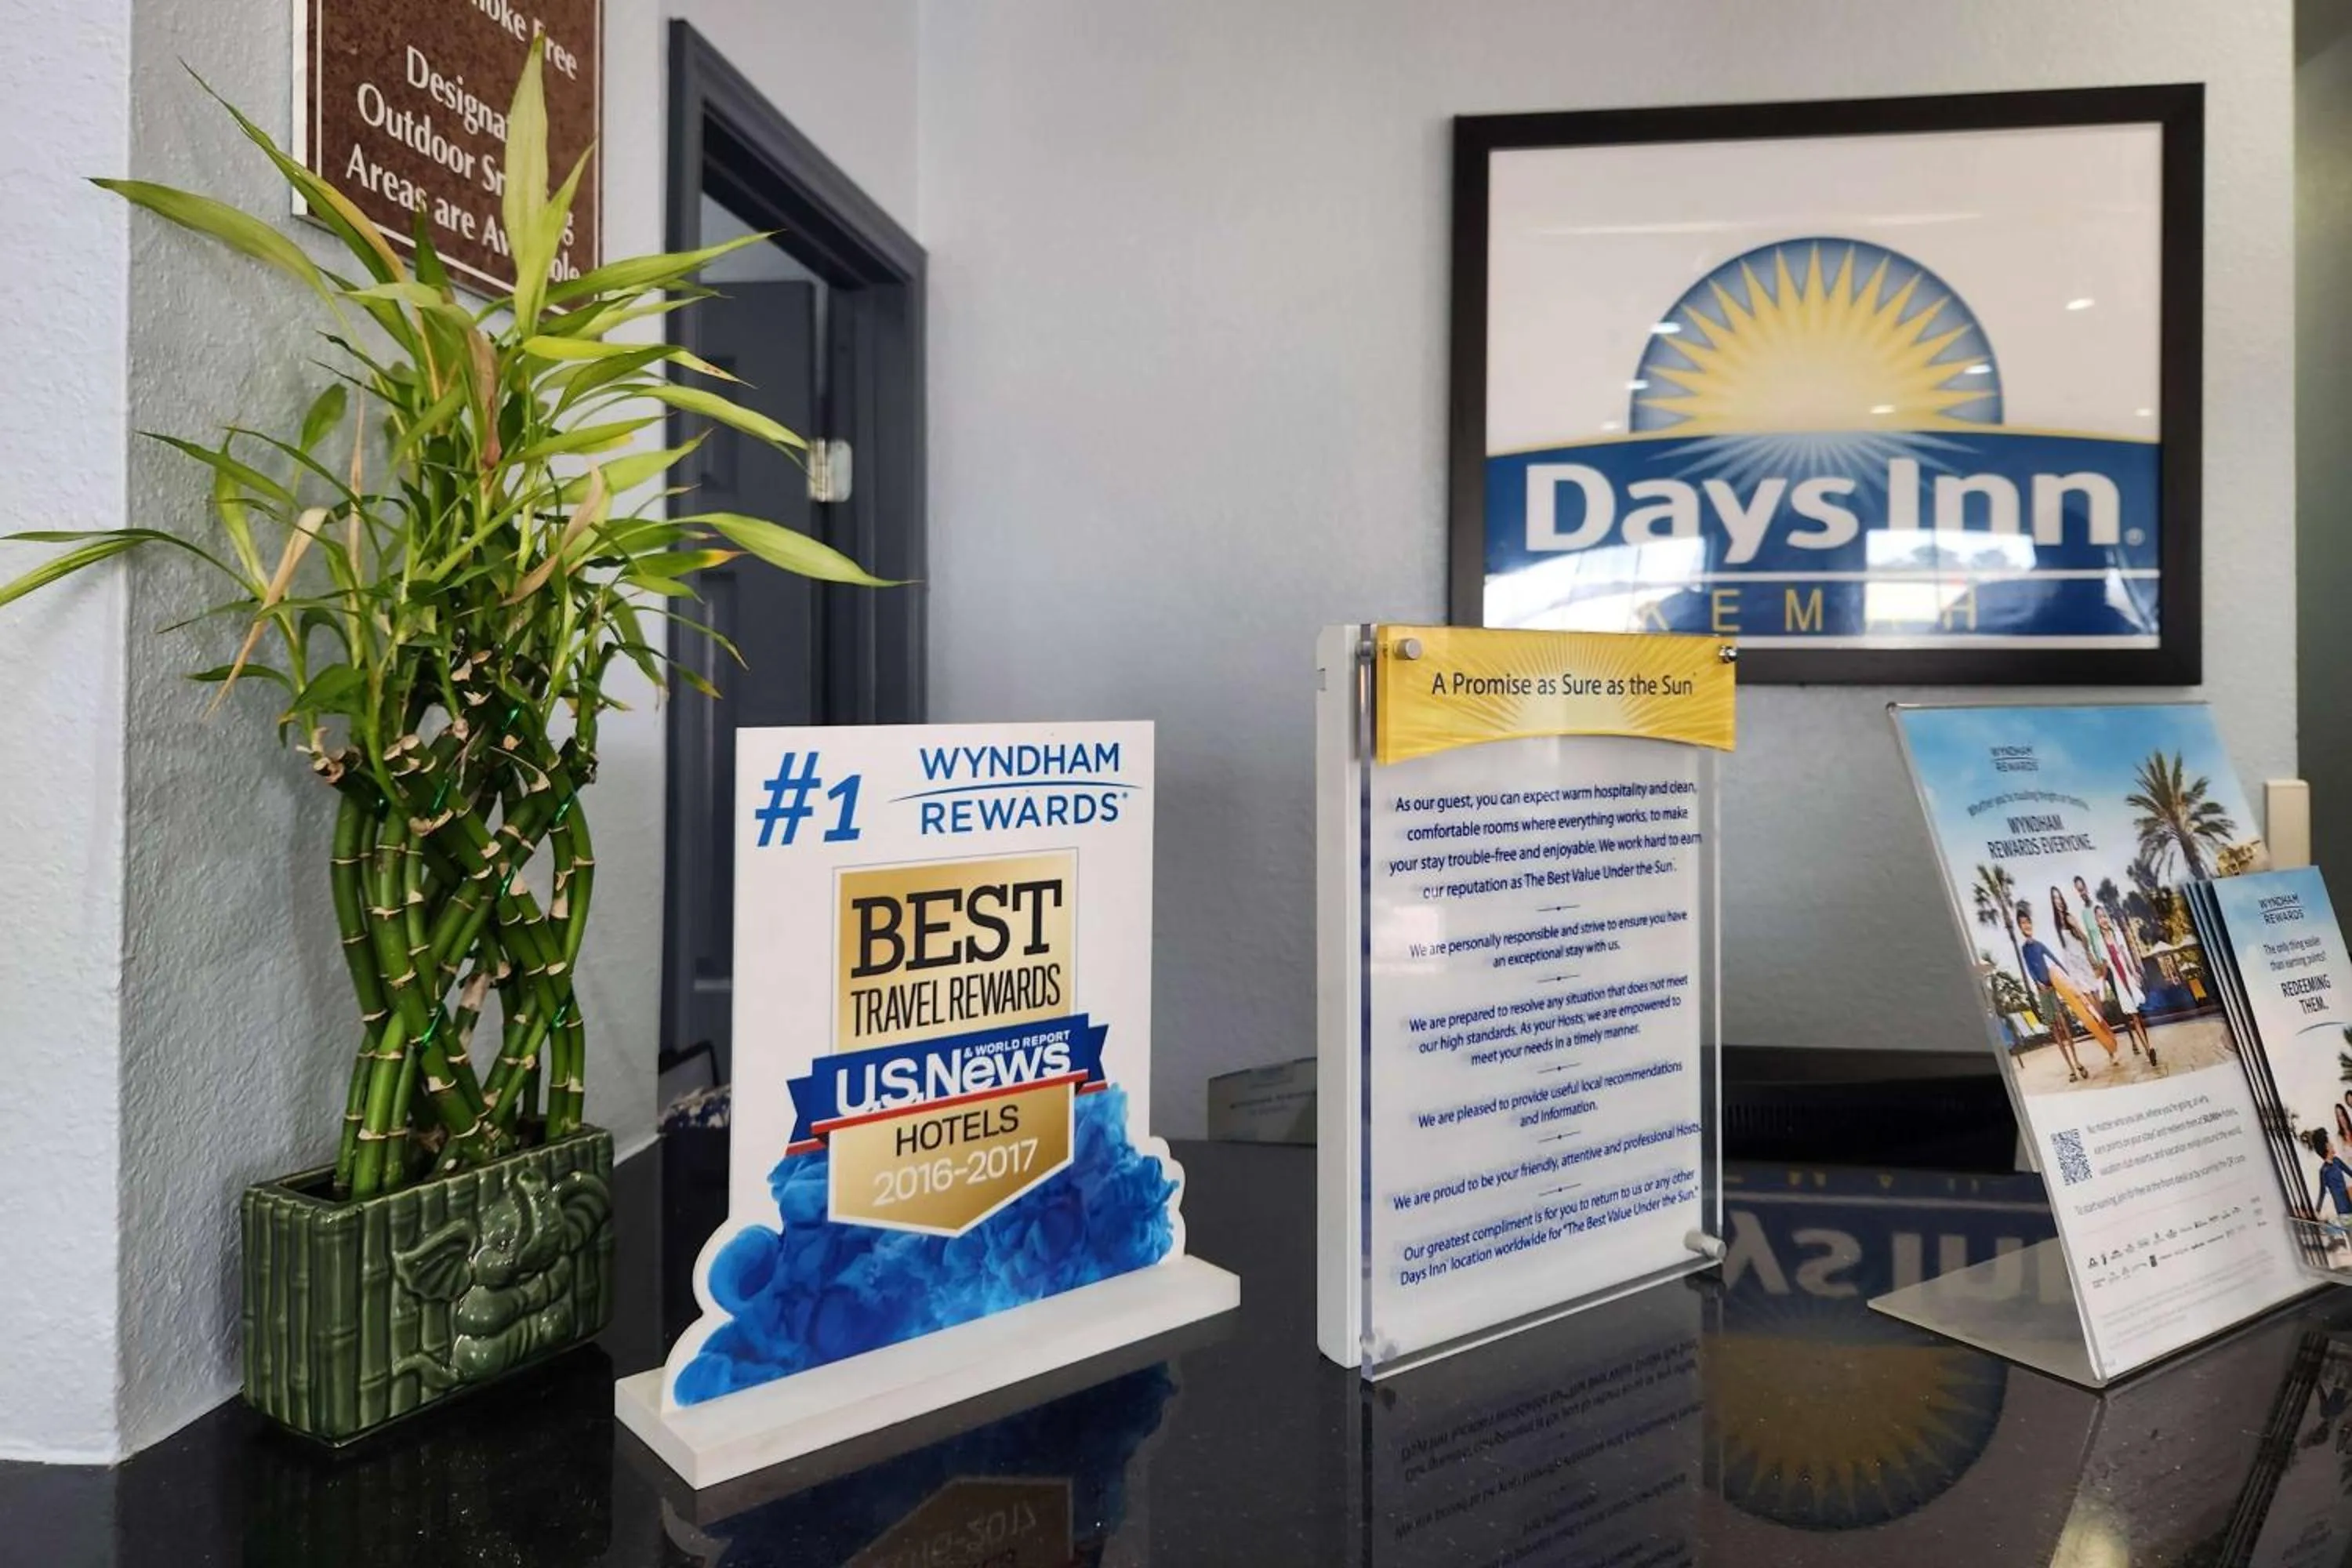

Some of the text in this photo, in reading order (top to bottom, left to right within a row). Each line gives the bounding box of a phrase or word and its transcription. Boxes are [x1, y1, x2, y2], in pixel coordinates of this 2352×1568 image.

[358, 83, 477, 180] Outdoor
[346, 143, 426, 212] Areas
[434, 198, 475, 239] are
[1526, 463, 1858, 563] Days
[1432, 673, 1446, 695] A
[1453, 672, 1531, 695] Promise
[1537, 677, 1556, 695] as
[1563, 674, 1602, 695] Sure
[1607, 678, 1624, 695] as
[1630, 674, 1657, 695] the
[755, 742, 1120, 847] #1 WYNDHAM
[1396, 797, 1410, 811] As
[1414, 800, 1435, 810] our
[1437, 795, 1473, 812] guest,
[1476, 794, 1497, 809] you
[1500, 793, 1519, 804] can
[1523, 790, 1559, 805] expect
[1563, 789, 1592, 800] warm
[1595, 784, 1646, 800] hospitality
[1650, 782, 1667, 794] and
[1407, 806, 1688, 840] comfortable rooms where everything works, to make
[1987, 837, 2042, 858] REWARDS
[1389, 833, 1702, 877] your stay trouble-free and enjoyable. We work hard to earn
[1423, 885, 1443, 898] our
[1446, 878, 1508, 898] reputation
[1511, 877, 1522, 888] as
[1524, 873, 1545, 885] The
[1547, 869, 1570, 886] Best
[1572, 867, 1600, 882] Value
[1602, 863, 1634, 879] Under
[1636, 862, 1653, 875] the
[851, 880, 1062, 978] BEST
[1430, 943, 1446, 955] are
[1449, 933, 1502, 956] personally
[1503, 926, 1559, 946] responsible
[1561, 923, 1578, 937] and
[1619, 917, 1647, 928] ensure
[1650, 915, 1667, 927] you
[1668, 911, 1687, 922] have
[2263, 909, 2304, 924] REWARDS
[1493, 940, 1621, 967] an exceptional stay with us.
[851, 963, 1062, 1036] TRAVEL REWARDS
[1410, 1019, 1427, 1033] We
[1430, 1017, 1446, 1029] are
[1449, 1005, 1494, 1029] prepared
[1497, 1006, 1508, 1017] to
[1510, 998, 1544, 1014] resolve
[1547, 996, 1563, 1010] any
[1566, 989, 1606, 1005] situation
[1607, 985, 1625, 997] that
[1628, 982, 1648, 994] does
[2281, 974, 2331, 997] REDEEMING
[975, 1038, 1020, 1055] WORLD
[1023, 1029, 1071, 1047] REPORT
[1419, 996, 1681, 1054] our high standards. As your Hosts, we are empowered to
[1472, 1023, 1639, 1066] meet your needs in a timely manner.
[1418, 1115, 1436, 1127] We
[1438, 1112, 1454, 1125] are
[1457, 1099, 1497, 1123] pleased
[1499, 1098, 1509, 1110] to
[1512, 1090, 1548, 1109] provide
[1551, 1083, 1579, 1098] useful
[1604, 1061, 1682, 1086] recommendations
[1520, 1100, 1598, 1127] and information.
[896, 1105, 1019, 1156] HOTELS
[873, 1138, 1038, 1207] 2016-2017
[1394, 1196, 1411, 1210] We
[1414, 1193, 1430, 1206] are
[1433, 1179, 1465, 1203] proud
[1468, 1178, 1479, 1191] to
[1481, 1174, 1494, 1187] be
[1497, 1169, 1519, 1186] your
[1561, 1148, 1602, 1167] attentive
[1604, 1140, 1621, 1154] and
[1624, 1125, 1675, 1153] professional
[1400, 1270, 1426, 1285] Days
[1429, 1263, 1446, 1276] Inn
[1451, 1250, 1491, 1269] location
[1494, 1231, 1546, 1256] worldwide
[1548, 1227, 1563, 1240] for
[1587, 1215, 1606, 1229] Best
[1607, 1207, 1632, 1222] Value
[1634, 1200, 1661, 1215] Under
[1662, 1194, 1676, 1207] the
[1404, 1246, 1425, 1261] Our
[1427, 1232, 1470, 1258] greatest
[1472, 1216, 1532, 1239] compliment
[1534, 1210, 1543, 1223] is
[1544, 1207, 1559, 1219] for
[1559, 1202, 1577, 1219] you
[1580, 1200, 1588, 1210] to
[1592, 1192, 1619, 1207] return
[1621, 1188, 1630, 1199] to
[1632, 1184, 1642, 1195] us
[1655, 1177, 1670, 1189] any
[1671, 1168, 1694, 1184] other
